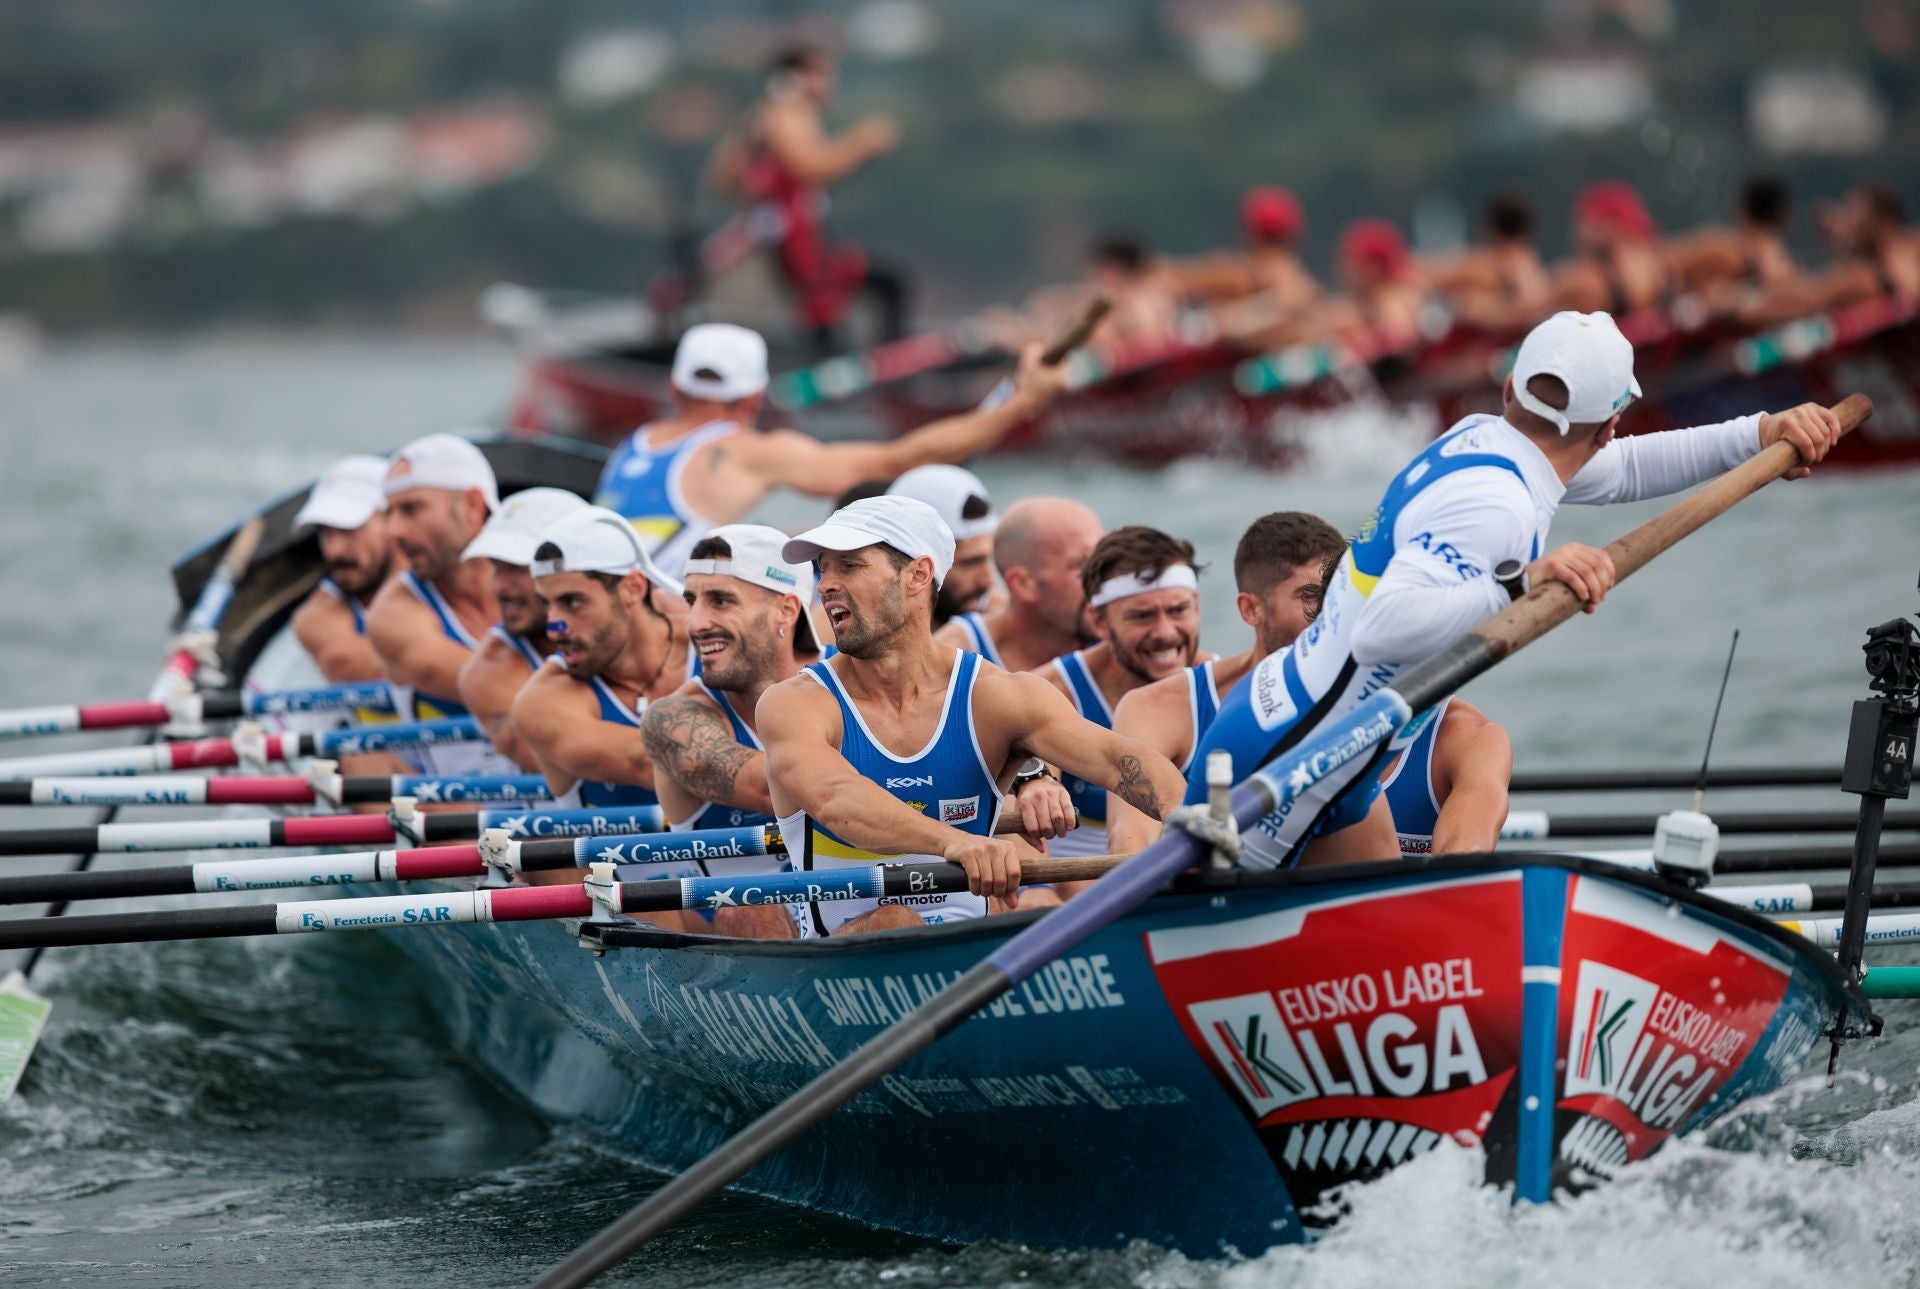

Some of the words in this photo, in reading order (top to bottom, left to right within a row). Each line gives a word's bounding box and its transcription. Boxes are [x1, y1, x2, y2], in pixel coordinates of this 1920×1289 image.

[1311, 711, 1394, 778] CaixaBank
[1886, 739, 1908, 761] 4A
[144, 790, 189, 805] SAR
[957, 805, 976, 816] LIGA
[532, 814, 642, 837] CaixaBank
[631, 837, 745, 863] CaixaBank
[310, 873, 355, 887] SAR
[742, 882, 861, 905] CaixaBank
[878, 893, 949, 908] Galmotor
[403, 906, 453, 924] SAR
[1754, 898, 1795, 913] SAR
[813, 976, 888, 1026] SANTA
[1019, 953, 1125, 1015] LUBRE
[1278, 973, 1379, 1026] EUSKO
[1382, 957, 1485, 1008] LABEL
[1649, 990, 1713, 1051] EUSKO
[1702, 1018, 1748, 1067] LABEL
[1296, 1003, 1488, 1098] LIGA
[1615, 1031, 1717, 1130] LIGA
